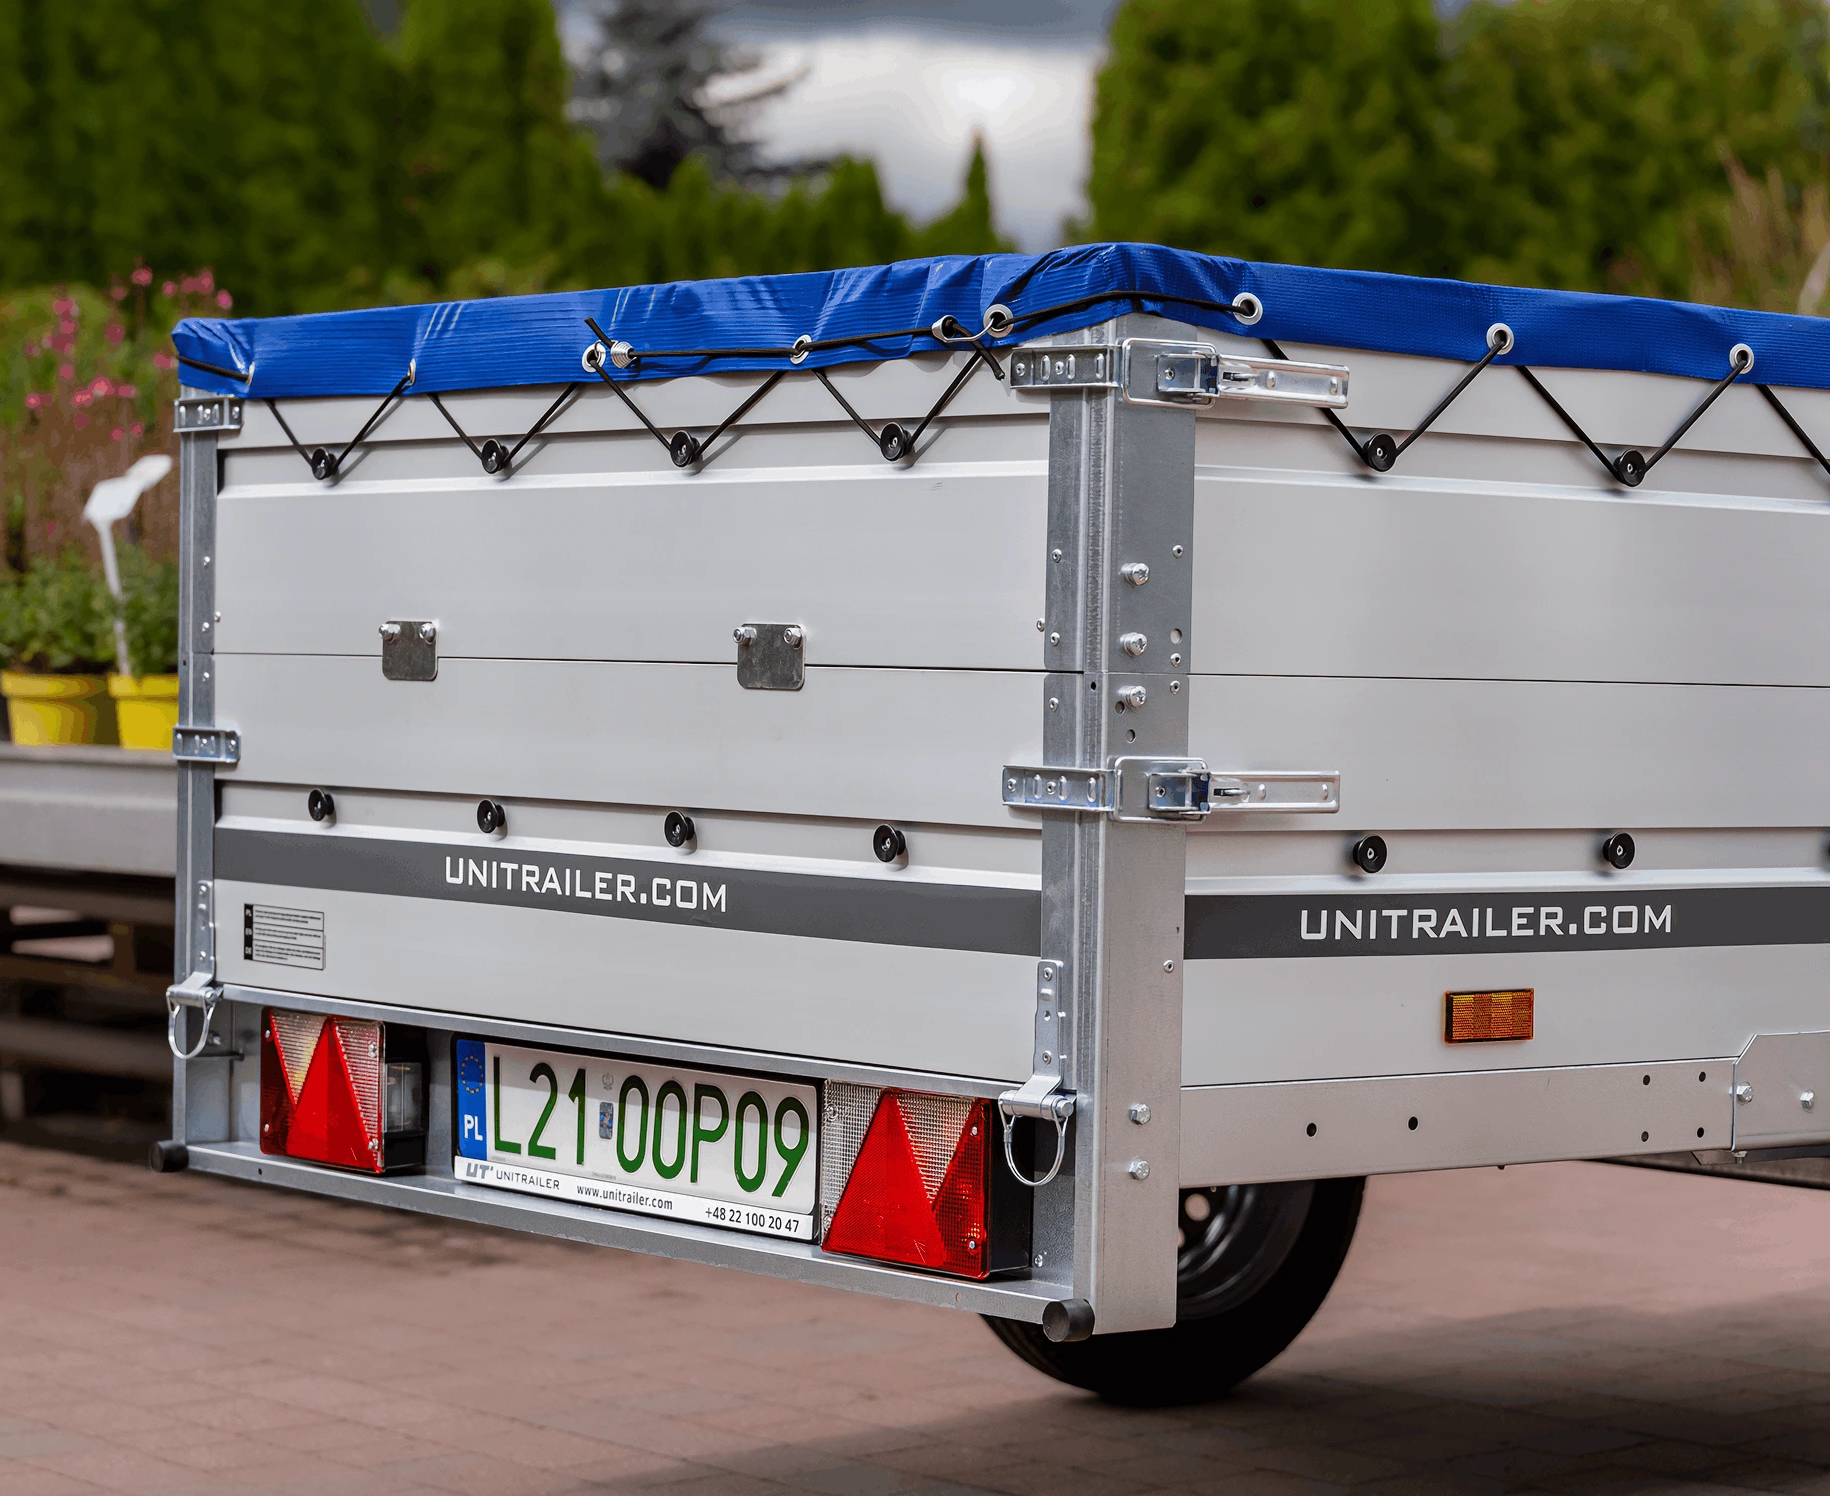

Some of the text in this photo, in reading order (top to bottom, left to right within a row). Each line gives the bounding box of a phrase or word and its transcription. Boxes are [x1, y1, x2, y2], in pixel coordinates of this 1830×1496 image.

[444, 855, 728, 913] UNITRAILER.COM
[1299, 904, 1673, 941] UNITRAILER.COM
[493, 1055, 587, 1165] L21
[463, 1113, 484, 1141] PL
[496, 1170, 560, 1190] UNITRAILER
[576, 1185, 673, 1210] www.unitrailer.com
[705, 1207, 800, 1233] +48 22 100 20 47
